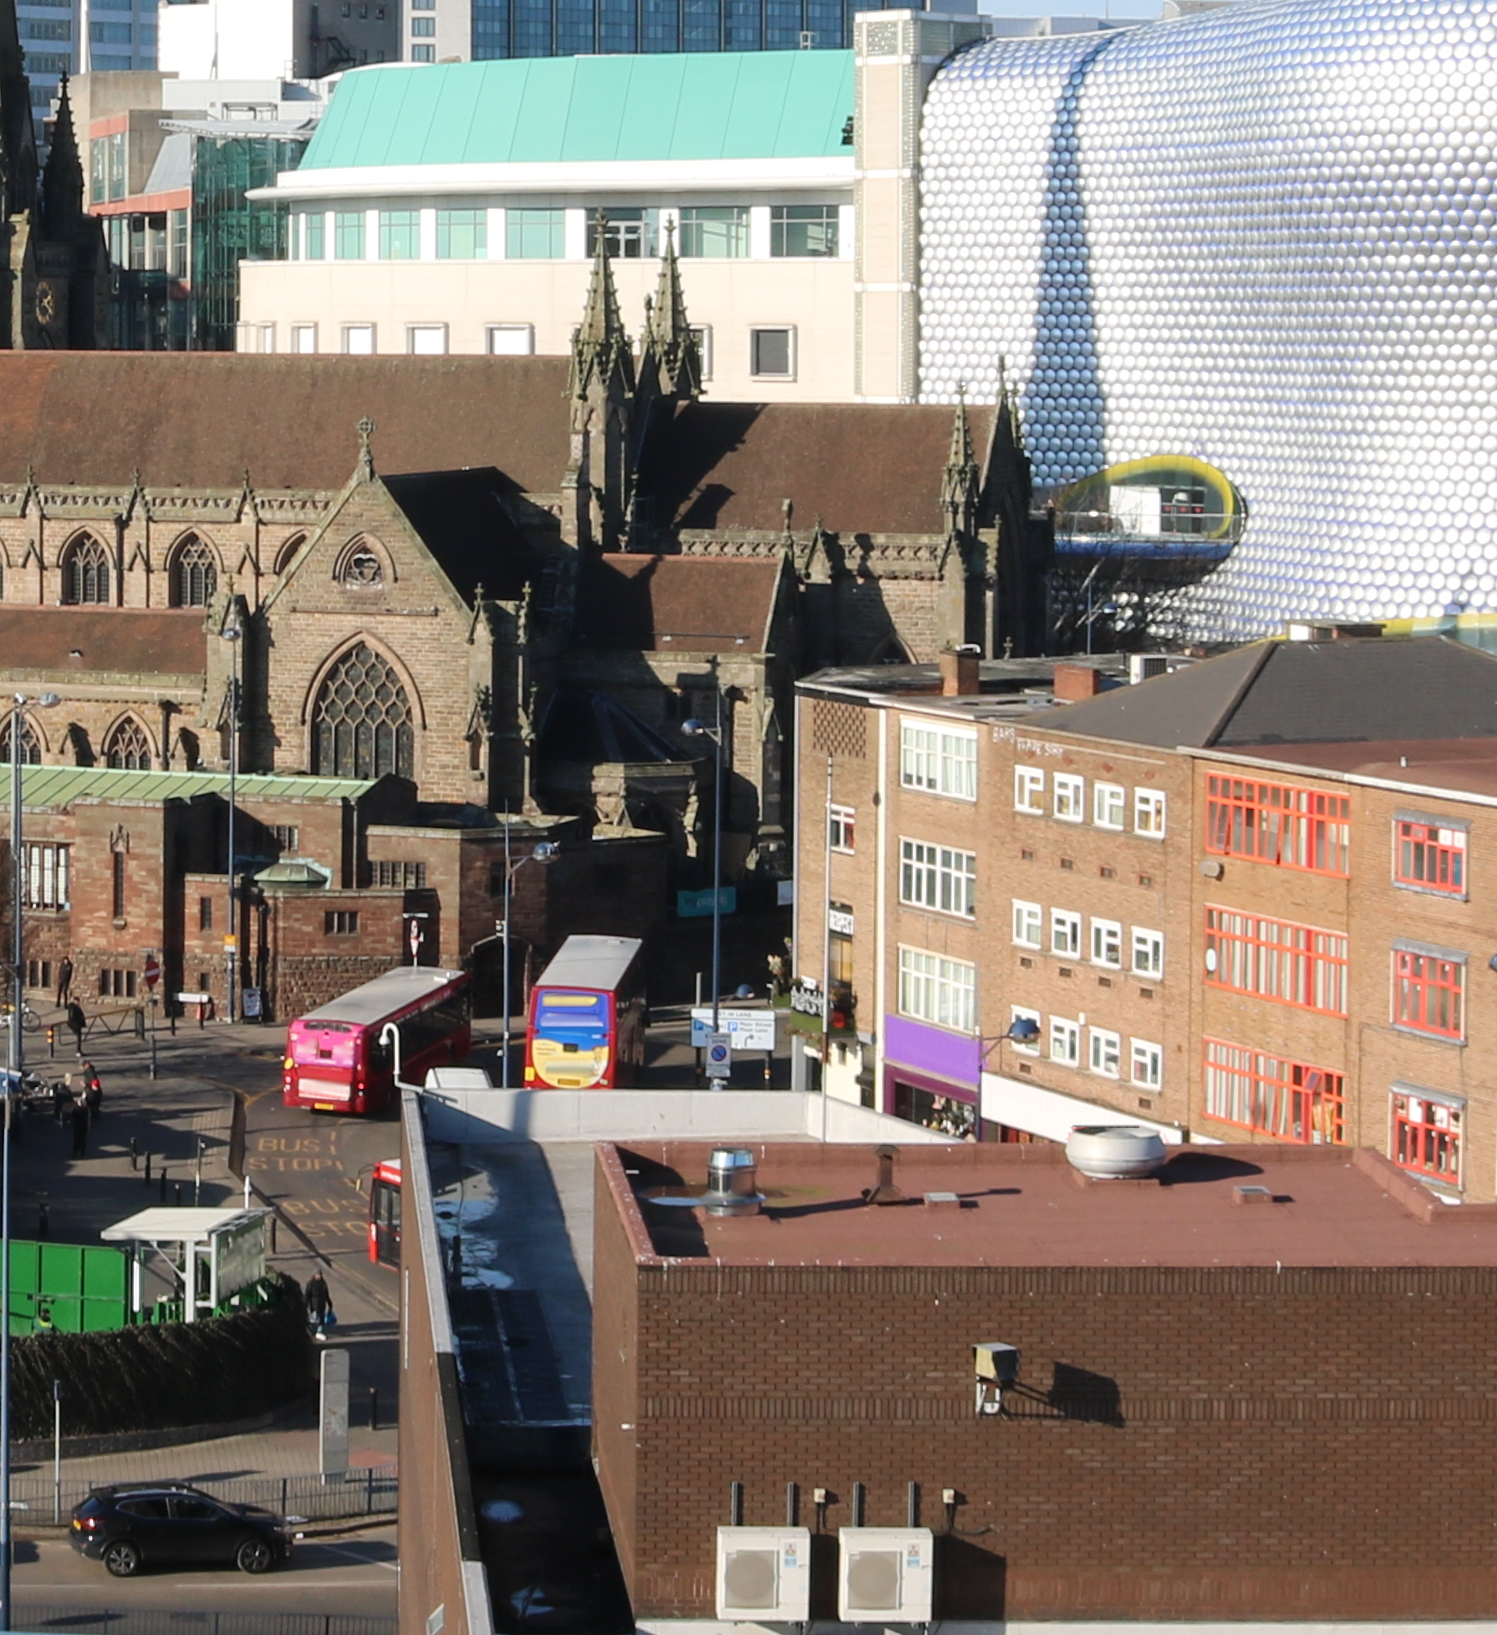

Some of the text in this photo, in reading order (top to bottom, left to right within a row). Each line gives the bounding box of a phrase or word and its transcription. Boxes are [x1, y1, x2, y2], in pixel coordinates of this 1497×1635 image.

[258, 1137, 322, 1153] BUS
[249, 1156, 334, 1172] STOP
[282, 1198, 370, 1216] BUS
[299, 1220, 369, 1238] STO
